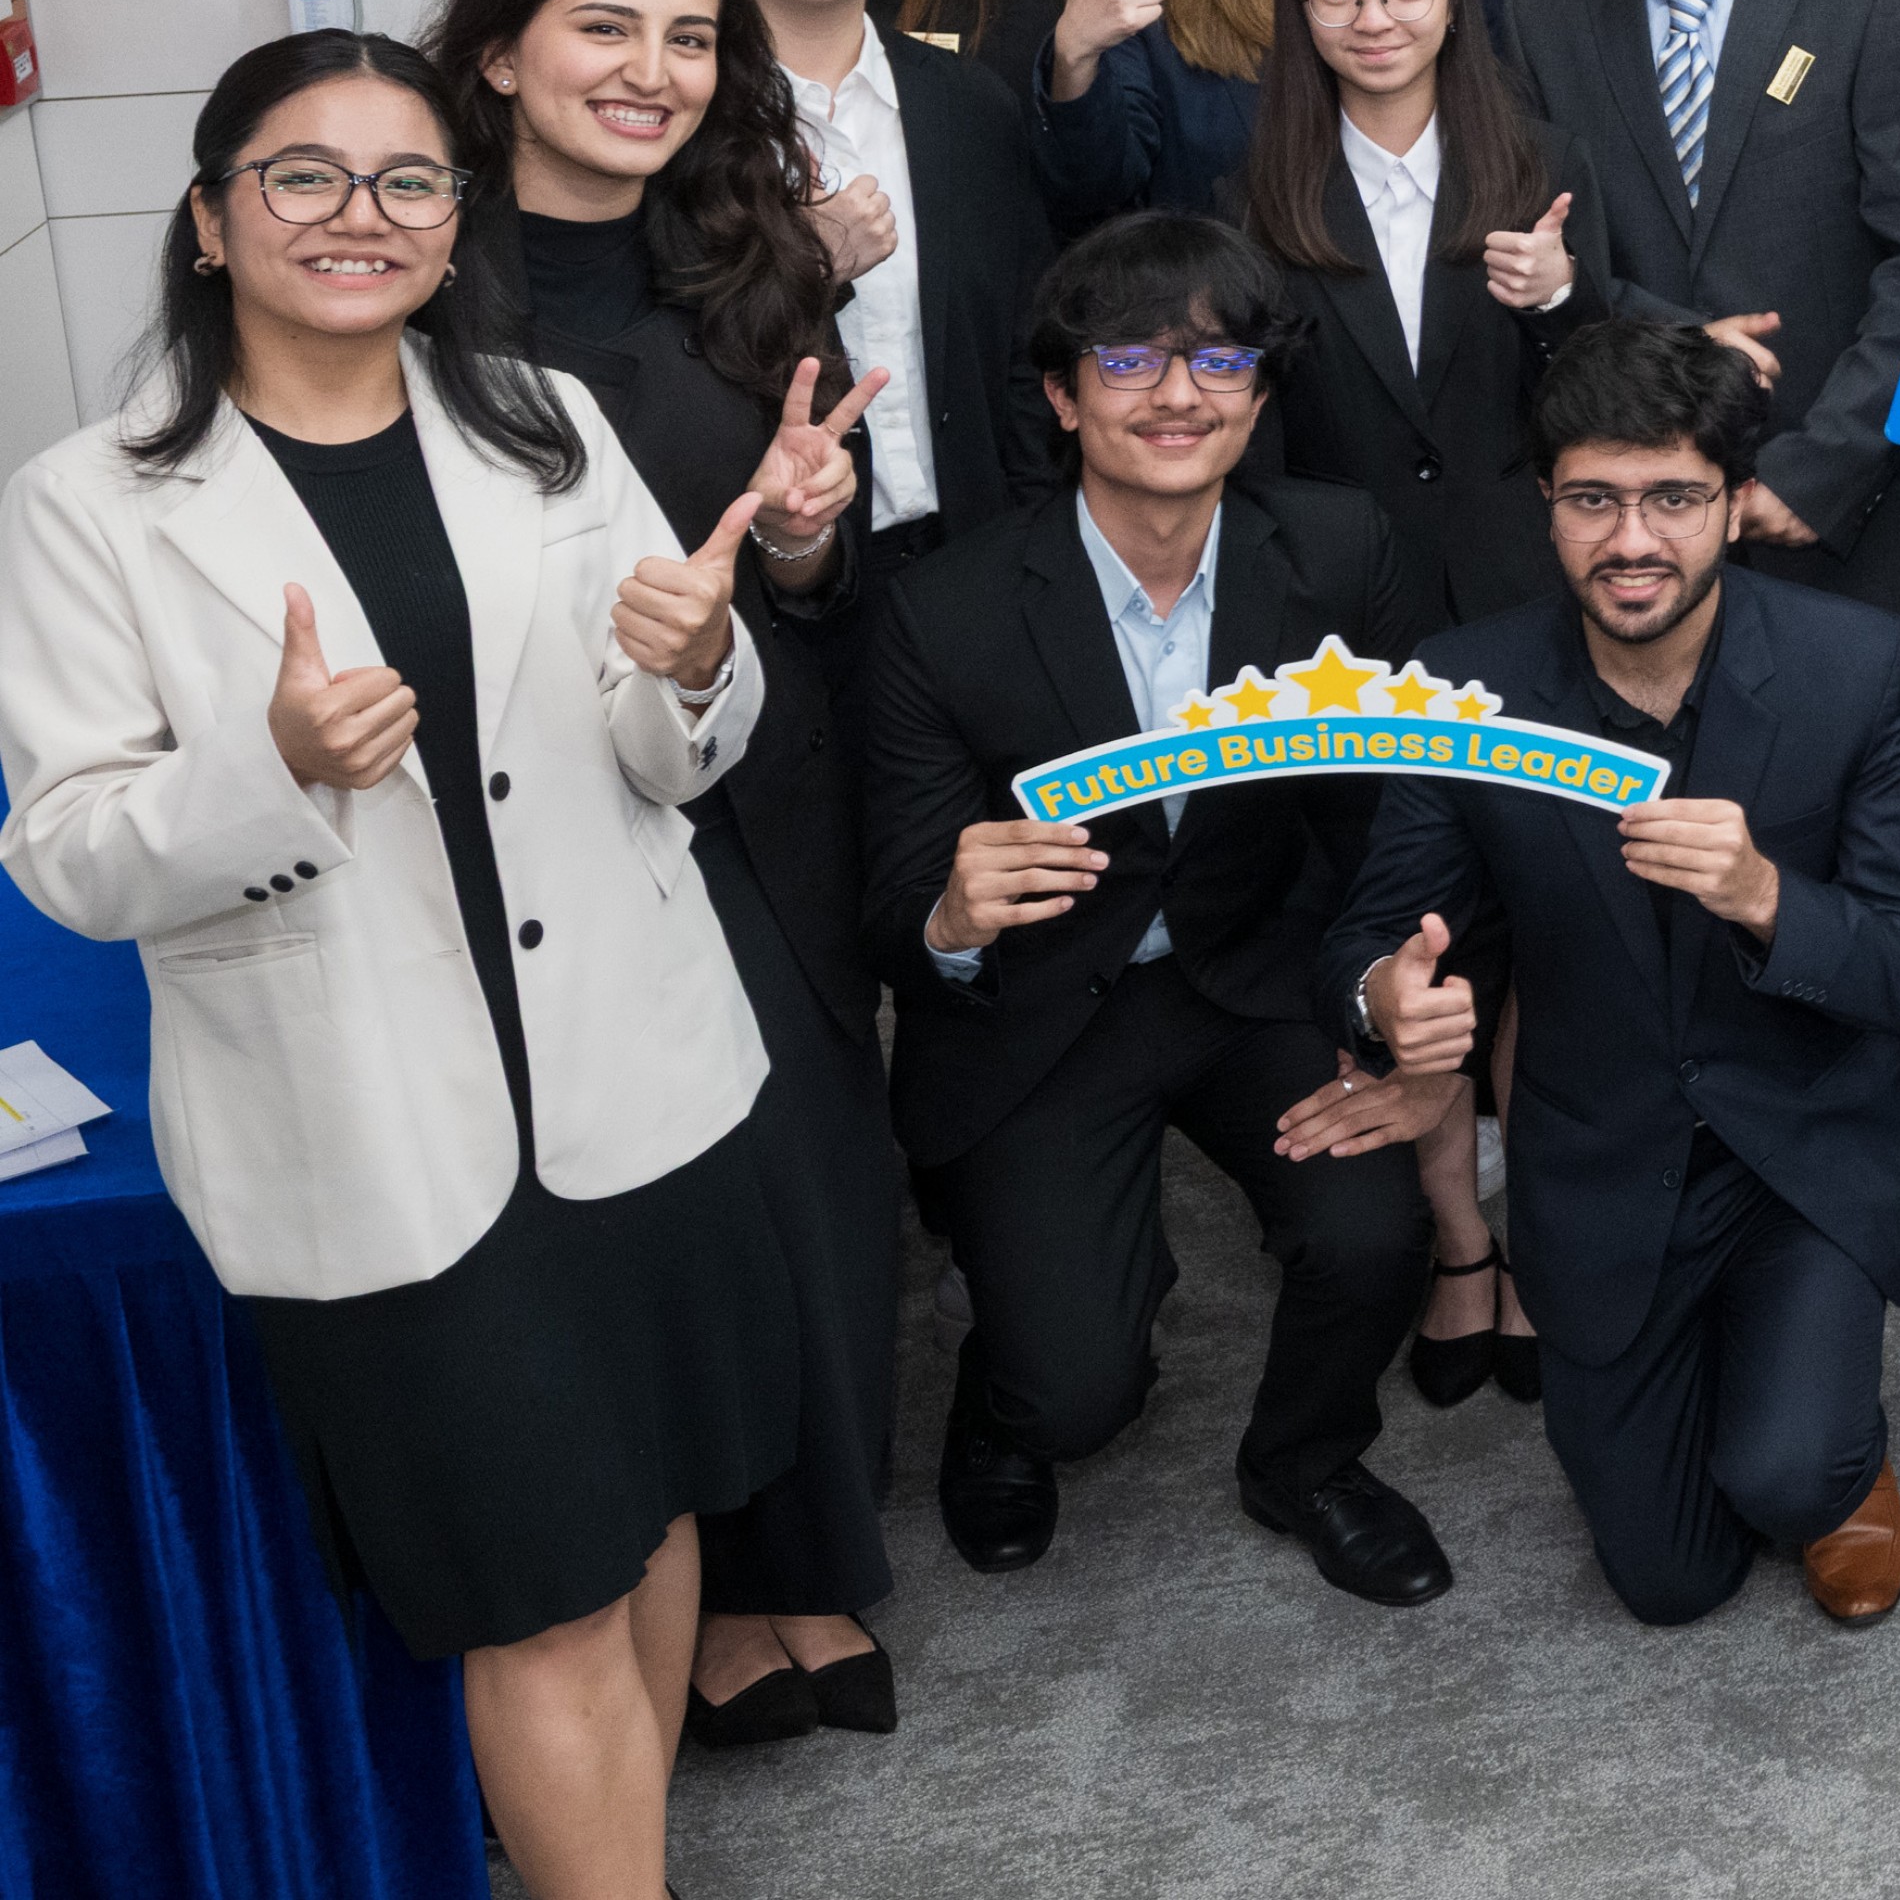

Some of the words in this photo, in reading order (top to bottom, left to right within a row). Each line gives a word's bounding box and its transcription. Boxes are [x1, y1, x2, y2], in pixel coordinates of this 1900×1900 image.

[1035, 747, 1208, 819] Future
[1218, 723, 1455, 770] Business
[1467, 732, 1644, 803] Leader
